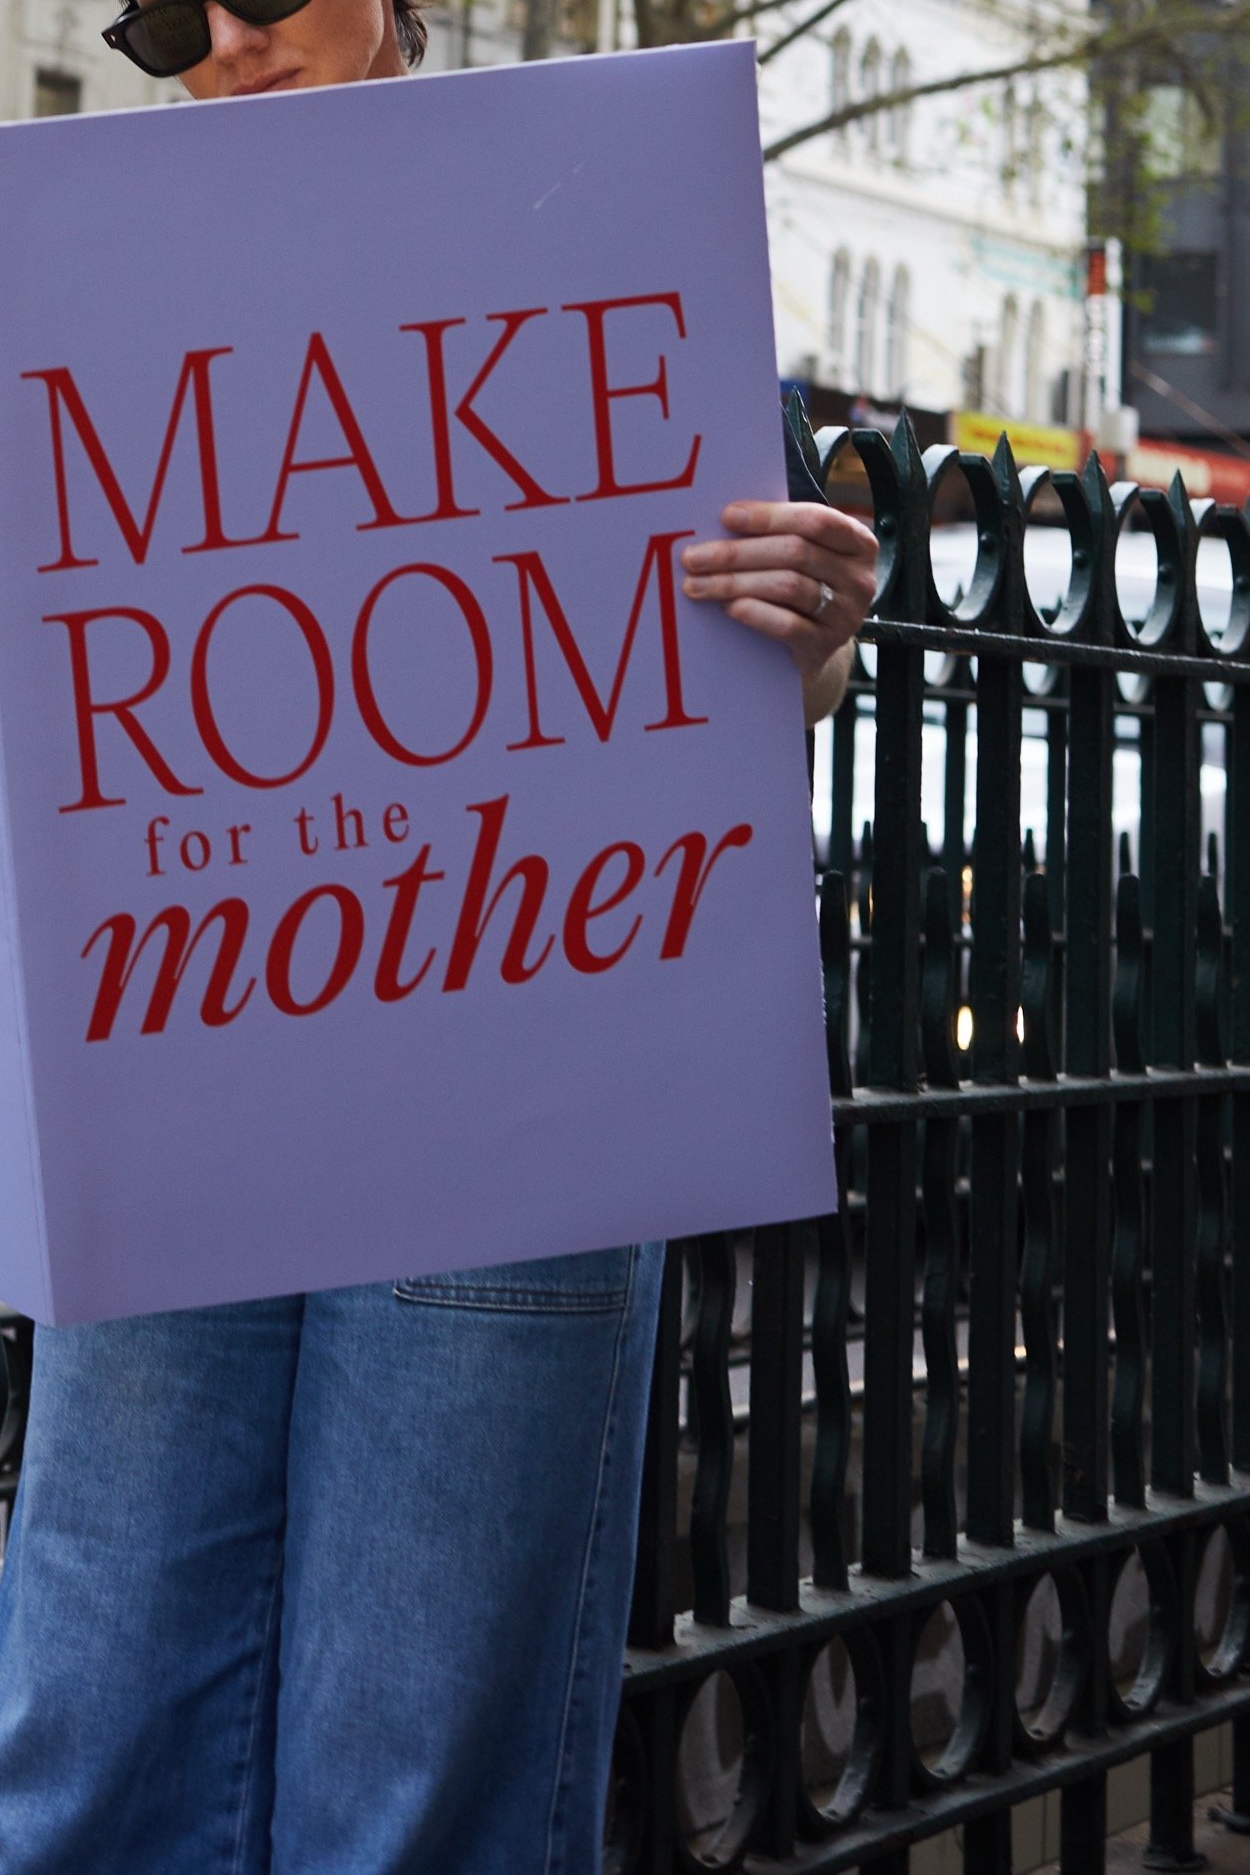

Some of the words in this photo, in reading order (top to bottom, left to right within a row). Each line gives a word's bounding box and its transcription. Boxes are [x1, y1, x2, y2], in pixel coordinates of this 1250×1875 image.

[20, 290, 704, 574] MAKE
[41, 528, 710, 815] ROOM
[79, 792, 754, 1045] mother
[144, 815, 253, 878] for
[294, 792, 411, 858] the
